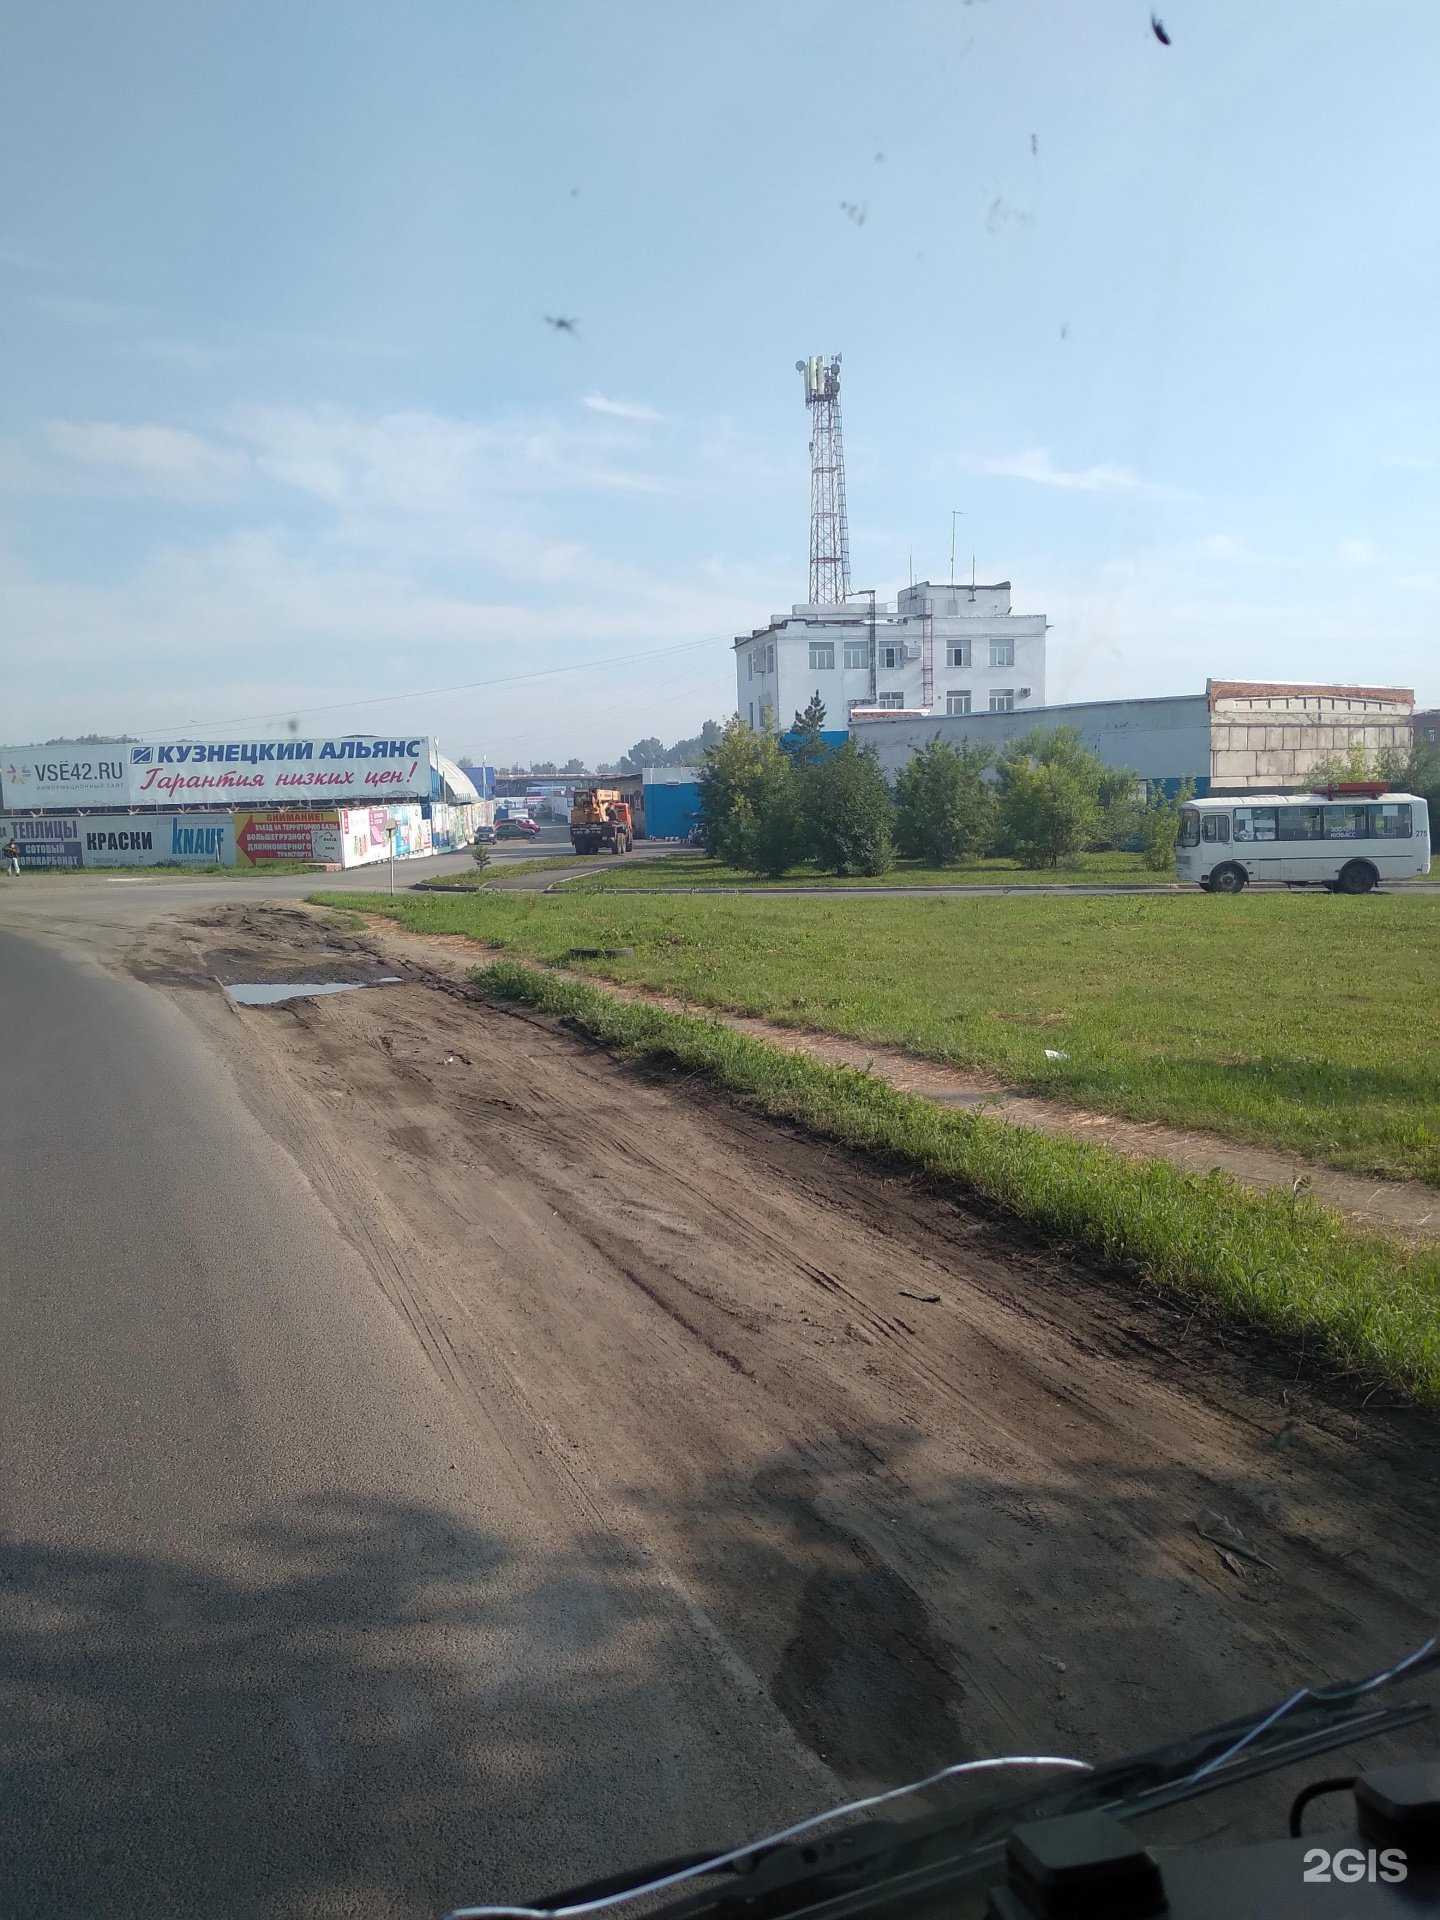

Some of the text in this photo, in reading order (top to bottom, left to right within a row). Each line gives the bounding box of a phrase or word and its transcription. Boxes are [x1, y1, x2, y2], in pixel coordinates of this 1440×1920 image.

[157, 740, 420, 764] КУЗНЕЦКИЙ АЛЬЯНС
[140, 761, 418, 798] Гарантия низких цен!
[266, 813, 324, 822] ВНИМАНИЕ!
[11, 820, 78, 841] ТЕПЛИЦЫ
[86, 831, 153, 851] КРАСКИ
[20, 856, 80, 866] ОЛИКАРБОНАТ
